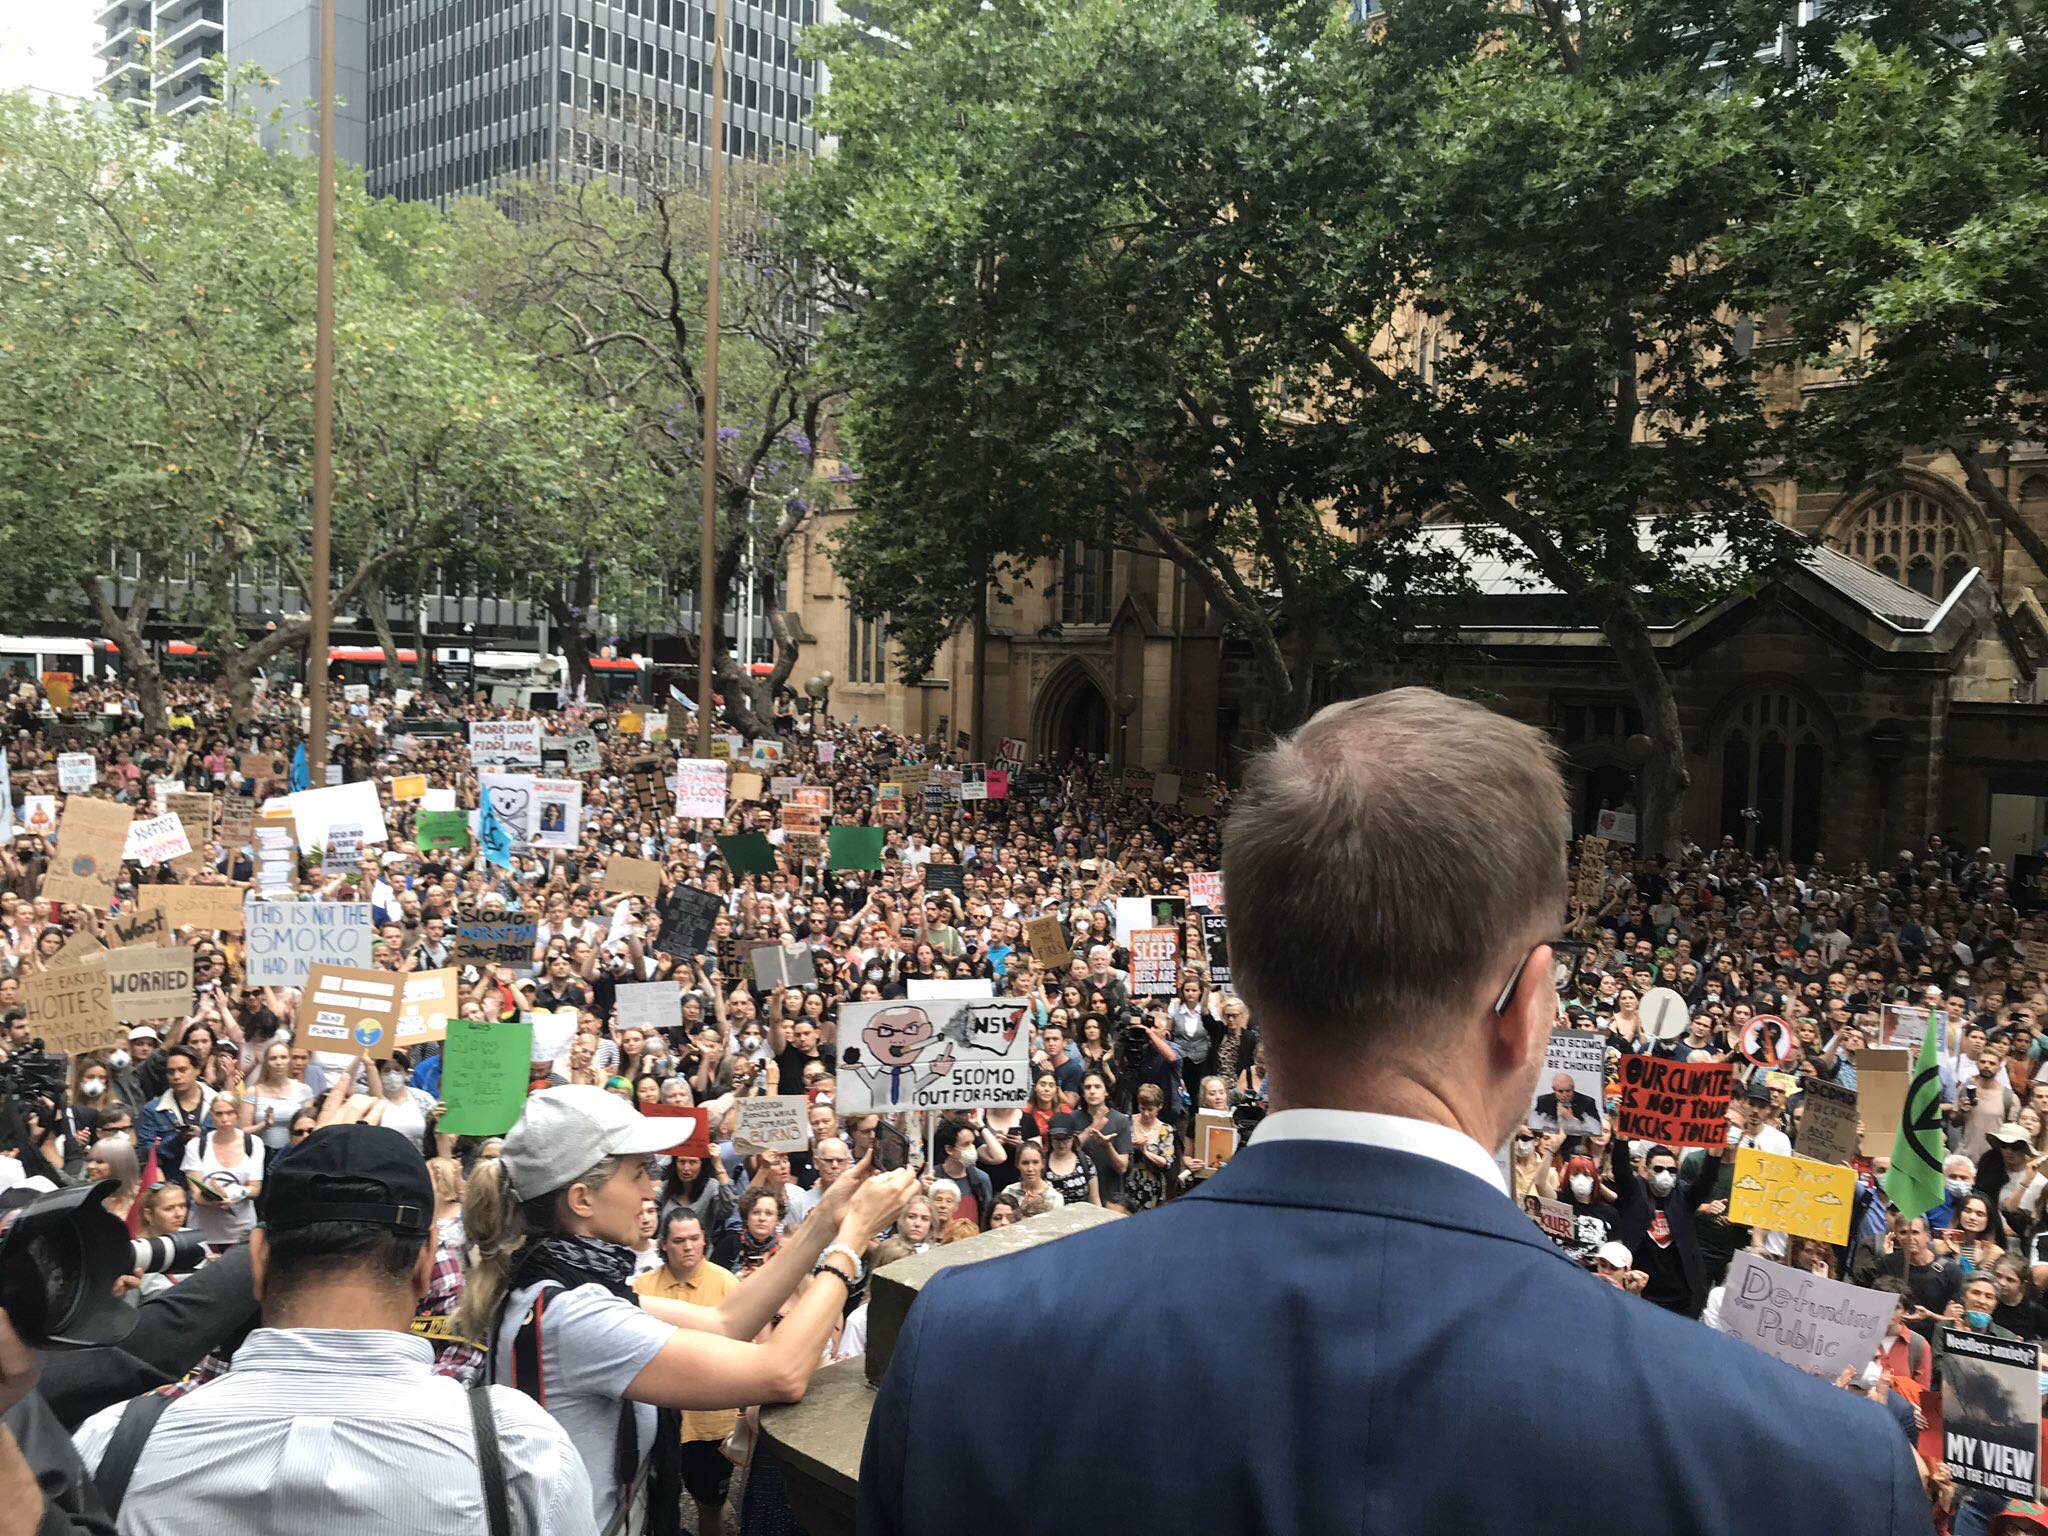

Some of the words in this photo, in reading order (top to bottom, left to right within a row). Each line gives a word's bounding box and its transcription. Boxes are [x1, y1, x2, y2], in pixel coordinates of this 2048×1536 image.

[474, 724, 534, 735] MORRISON
[474, 741, 532, 751] FIDDLING
[1001, 737, 1026, 760] KILL
[1191, 873, 1217, 884] NOT
[1192, 884, 1225, 895] HAPP
[249, 904, 284, 925] THIS
[291, 906, 308, 926] IS
[312, 905, 336, 926] NOT
[341, 904, 369, 925] THE
[250, 926, 360, 954] SMOKO
[718, 940, 736, 957] BE
[1133, 942, 1176, 960] SLEEP
[250, 959, 256, 974] I
[262, 957, 288, 974] HAD
[294, 956, 314, 975] IN
[1134, 961, 1159, 970] WHEN
[1159, 961, 1176, 970] OUR
[110, 970, 189, 994] WORRIED
[1135, 971, 1158, 981] BEDS
[1158, 971, 1176, 981] ARE
[1135, 983, 1177, 994] BURNING
[27, 987, 107, 1020] HOTTER
[320, 1013, 341, 1023] DEAD
[974, 1017, 1015, 1034] NSW
[311, 1026, 345, 1036] PLANET
[1568, 1039, 1602, 1049] SCOMO
[1575, 1050, 1601, 1060] LIKES
[1548, 1060, 1559, 1068] BE
[1563, 1061, 1601, 1072] CHOKED
[952, 1068, 1015, 1085] SCOMO
[1626, 1058, 1668, 1092] OUR
[1668, 1068, 1732, 1096] CLIMATE
[918, 1090, 950, 1106] OUT
[953, 1090, 981, 1102] FOR
[1621, 1086, 1639, 1108] IS
[1645, 1093, 1686, 1117] NOT
[1691, 1098, 1730, 1119] YOUR
[774, 1109, 798, 1117] WHILE
[742, 1118, 798, 1128] AUSTRALIA
[750, 1125, 800, 1143] BURNS
[1680, 1122, 1729, 1143] TOILET
[1540, 1214, 1572, 1237] KILLER
[1741, 1264, 1880, 1339] Defunding
[1756, 1307, 1840, 1357] Public
[1946, 1333, 1991, 1356] Needless
[1991, 1344, 2036, 1366] anxiety?
[1947, 1432, 1978, 1466] MY
[1980, 1440, 2035, 1481] VIEW
[1965, 1467, 1984, 1485] THE
[1984, 1471, 2005, 1490] LAST
[2006, 1477, 2034, 1498] WEEK
